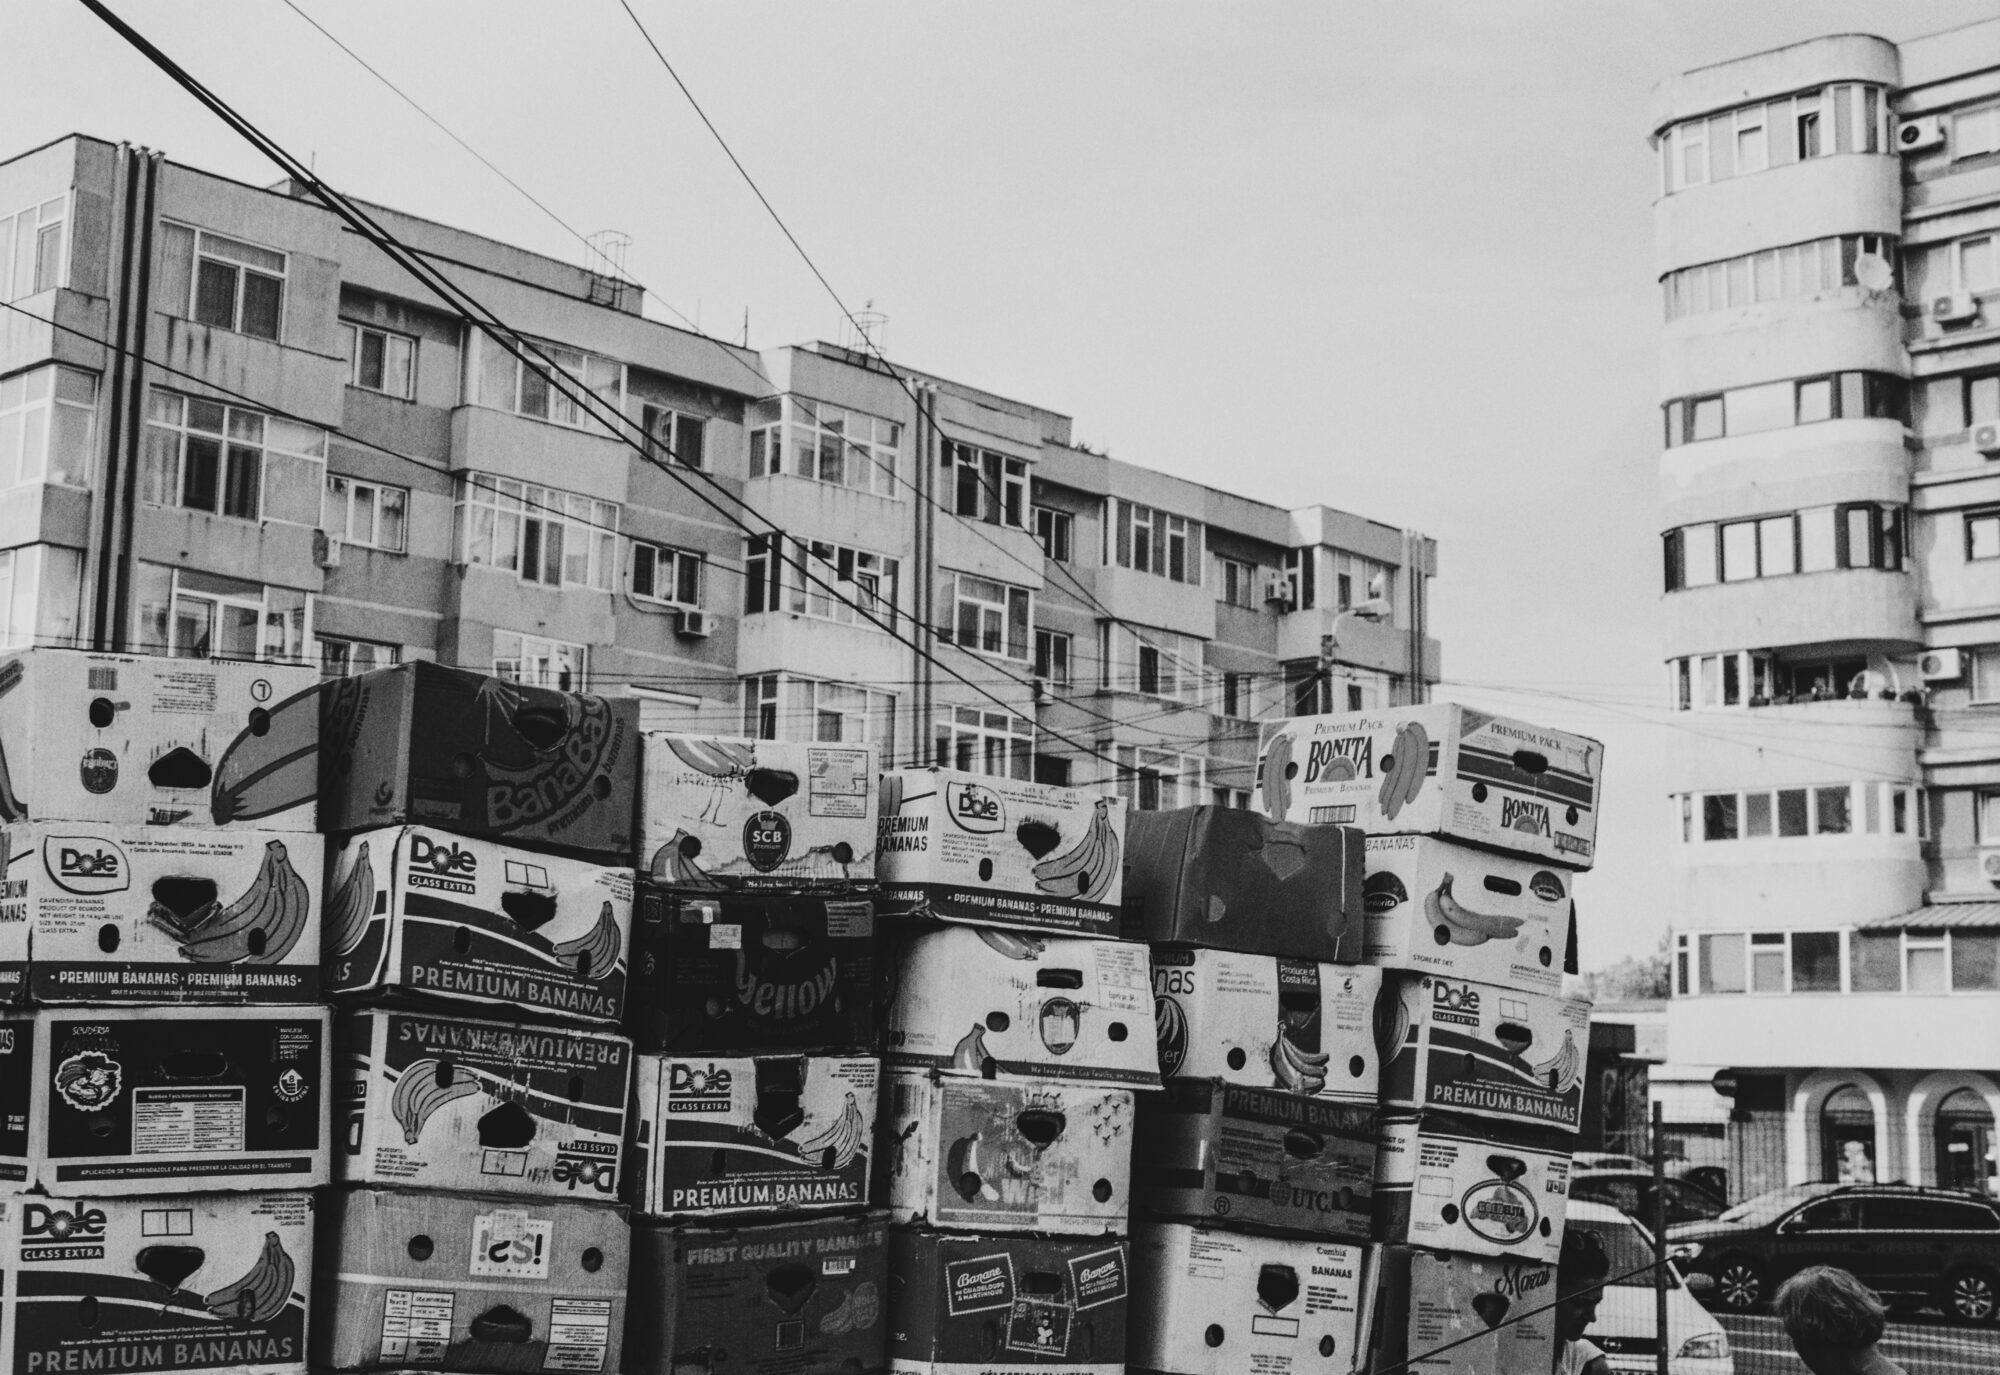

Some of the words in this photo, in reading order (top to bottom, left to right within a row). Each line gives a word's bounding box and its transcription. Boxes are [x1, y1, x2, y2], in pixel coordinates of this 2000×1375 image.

[602, 717, 625, 773] bananas
[1491, 723, 1536, 744] PREMIUM
[1539, 736, 1561, 750] PACK
[1304, 735, 1374, 784] BONITA
[958, 792, 998, 816] Dole
[878, 816, 928, 833] PREMIUM
[1501, 796, 1551, 838] BONITA
[753, 830, 782, 844] SCB
[876, 836, 928, 852] BANANAS
[1365, 837, 1415, 851] BANANAS
[61, 848, 118, 874] Dole
[411, 834, 477, 873] Dole
[411, 875, 441, 888] CLASS
[444, 881, 474, 894] EXTRA
[954, 893, 995, 907] PREMIUM
[997, 897, 1035, 912] BANANAS
[1041, 903, 1077, 918] PREMIUM
[1078, 907, 1111, 923] BANANAS
[1280, 965, 1304, 975] Produce
[1305, 967, 1316, 975] of
[1412, 954, 1432, 964] STORE
[59, 971, 119, 985] PREMIUM
[122, 972, 179, 985] BANANAS
[187, 973, 243, 986] PREMIUM
[245, 974, 297, 987] BANANAS
[1280, 975, 1301, 984] Costa
[1302, 976, 1317, 986] Rica
[412, 966, 520, 999] PREMIUM
[528, 983, 616, 1017] BANANAS
[1433, 980, 1480, 1009] Dole
[1434, 1012, 1455, 1022] CLASS
[1457, 1015, 1479, 1026] EXTRA
[400, 1021, 514, 1050] BANANAS
[520, 1033, 621, 1064] PREMIUM
[289, 1074, 295, 1083] 8
[670, 1062, 732, 1091] Dole
[671, 1102, 699, 1111] CLASS
[701, 1102, 729, 1111] EXTRA
[1227, 1088, 1304, 1121] PREMIUM
[1433, 1084, 1513, 1111] PREMIUM
[1516, 1095, 1575, 1122] BANANAS
[559, 1141, 587, 1151] EXTRA
[590, 1143, 617, 1154] CLASS
[553, 1160, 616, 1194] Dole
[673, 1184, 770, 1207] PREMIUM
[775, 1182, 858, 1202] BANANAS
[23, 1201, 107, 1238] Dole
[24, 1249, 60, 1260] CLASS
[65, 1248, 103, 1258] EXTRA
[687, 1247, 738, 1265] FIRST
[741, 1240, 813, 1261] QUALITY
[816, 1231, 883, 1253] BANANAS
[957, 1267, 1007, 1288] Banane
[1080, 1260, 1120, 1283] Banane
[1085, 1275, 1119, 1289] GUADELOUPE
[1311, 1265, 1353, 1279] BANANAS
[963, 1281, 1005, 1294] GUADELOUPE
[963, 1288, 1003, 1300] MARTINIQUE
[1086, 1281, 1118, 1295] MARTINIQUE
[28, 1346, 163, 1373] PREMIUM
[174, 1337, 293, 1366] BANANAS
